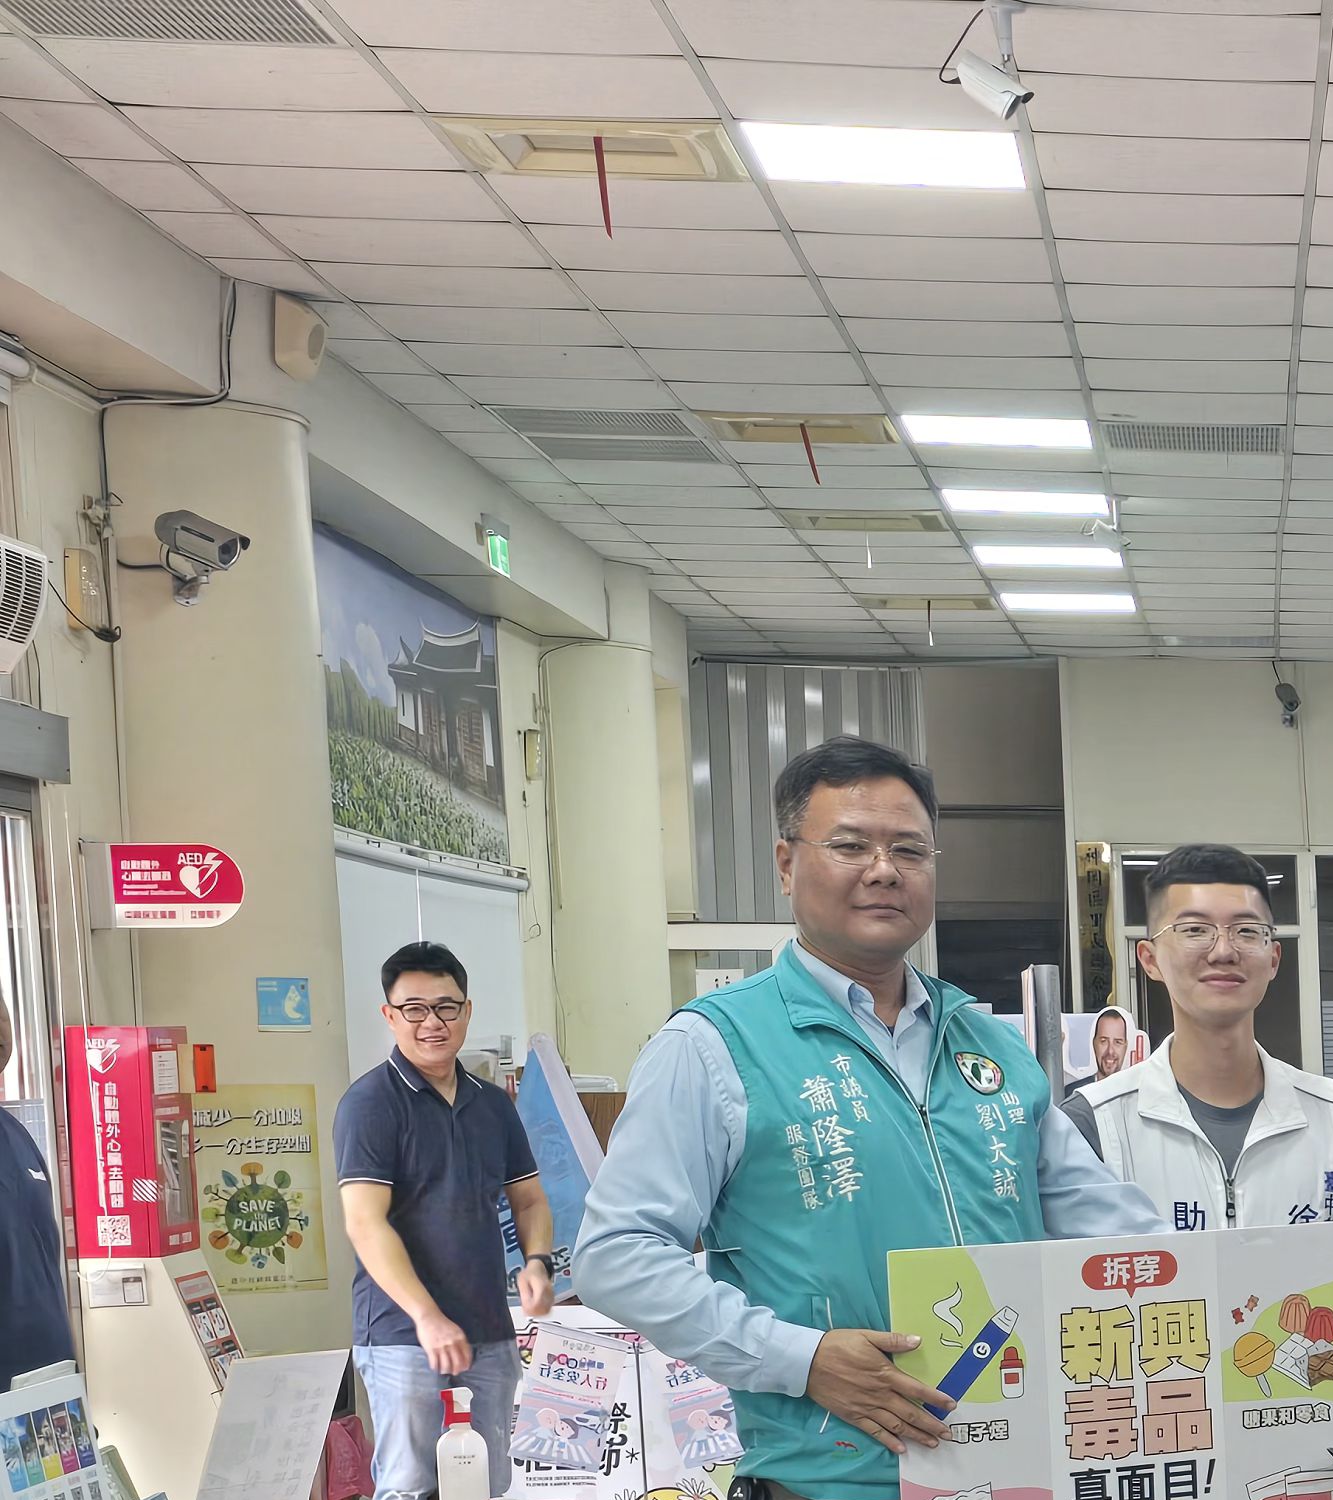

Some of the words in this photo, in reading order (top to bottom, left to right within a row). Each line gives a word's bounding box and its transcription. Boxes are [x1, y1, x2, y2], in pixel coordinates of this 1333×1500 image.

[178, 853, 202, 864] AED
[239, 1200, 275, 1213] SAVE
[233, 1216, 282, 1231] PLANET
[1103, 1255, 1161, 1286] 拆穿
[1059, 1299, 1211, 1384] 新興
[1064, 1377, 1214, 1461] 毒品
[1242, 1401, 1332, 1431] 糖果和零食
